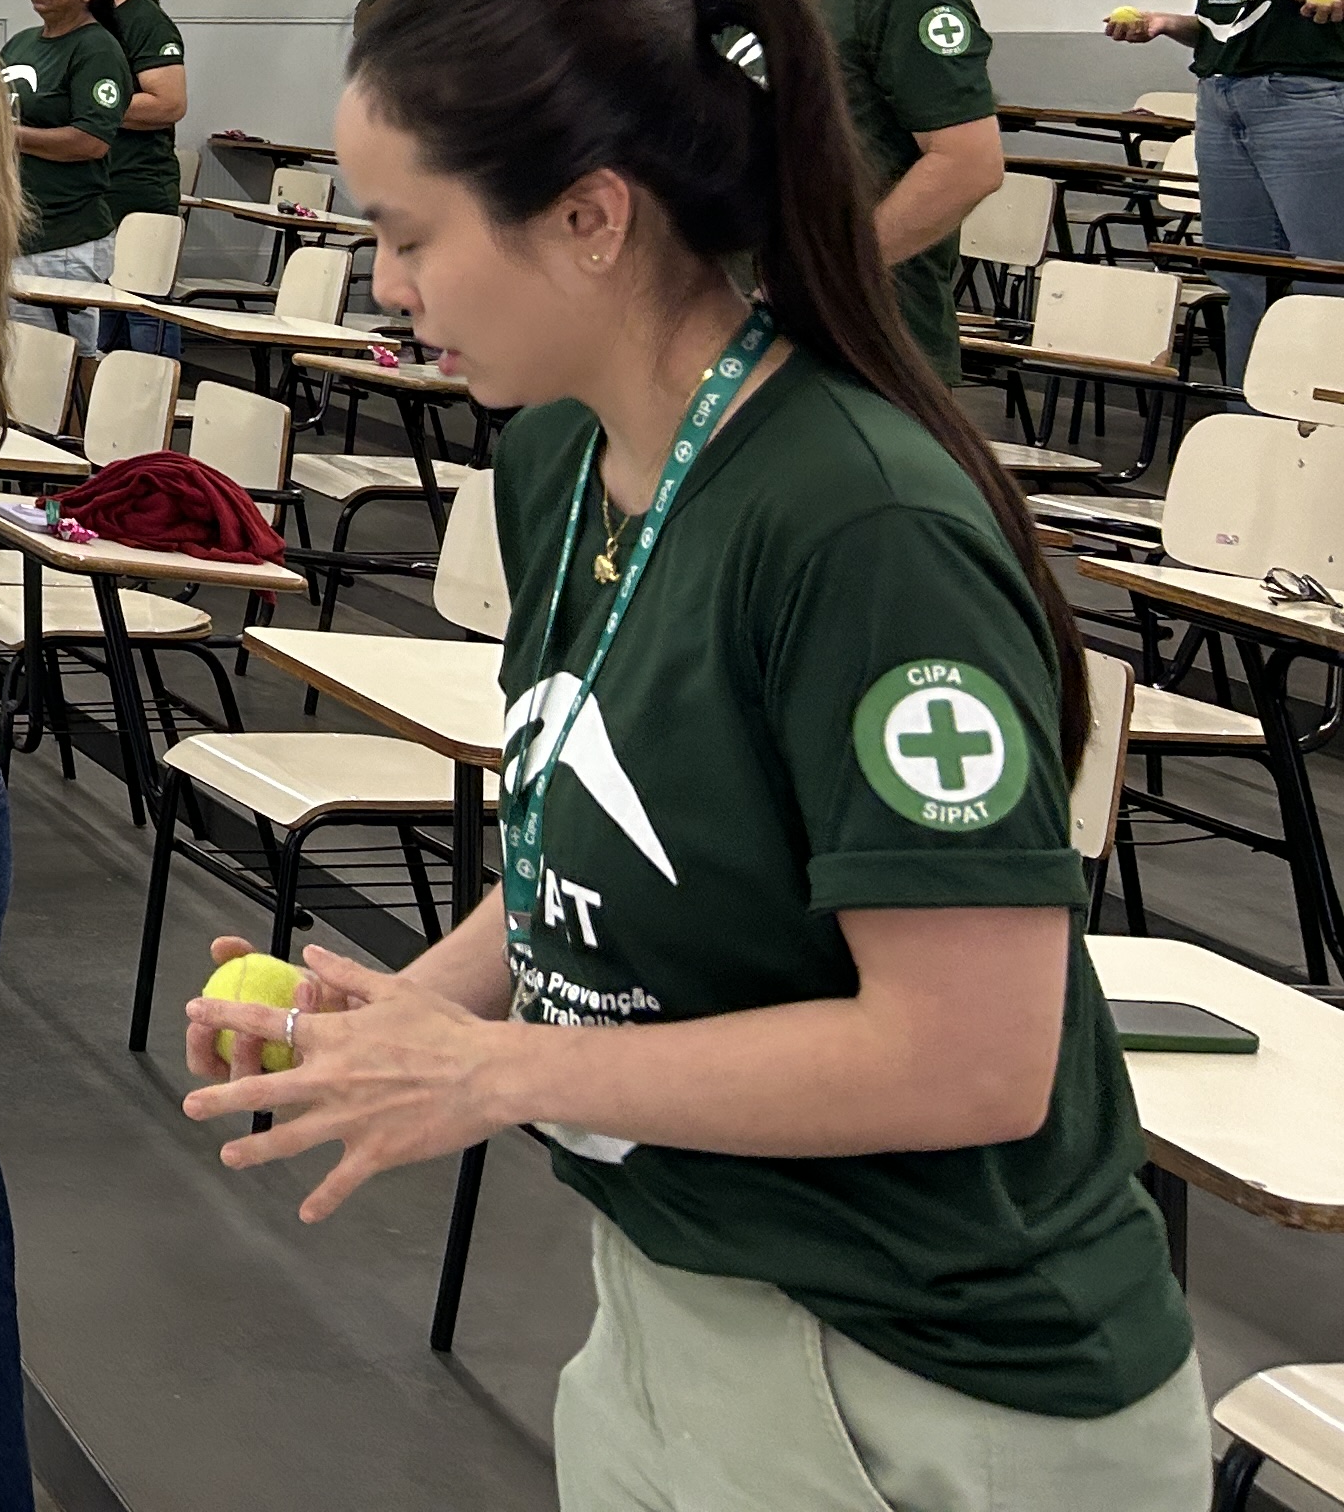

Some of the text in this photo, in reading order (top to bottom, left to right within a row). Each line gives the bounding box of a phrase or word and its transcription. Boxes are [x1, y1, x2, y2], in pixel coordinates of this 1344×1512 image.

[692, 392, 720, 427] CIPA
[655, 479, 675, 512] CIPA
[906, 664, 962, 686] CIPA
[922, 801, 989, 824] SIPAT
[537, 853, 603, 949] AT
[547, 972, 661, 1016] Prevenção
